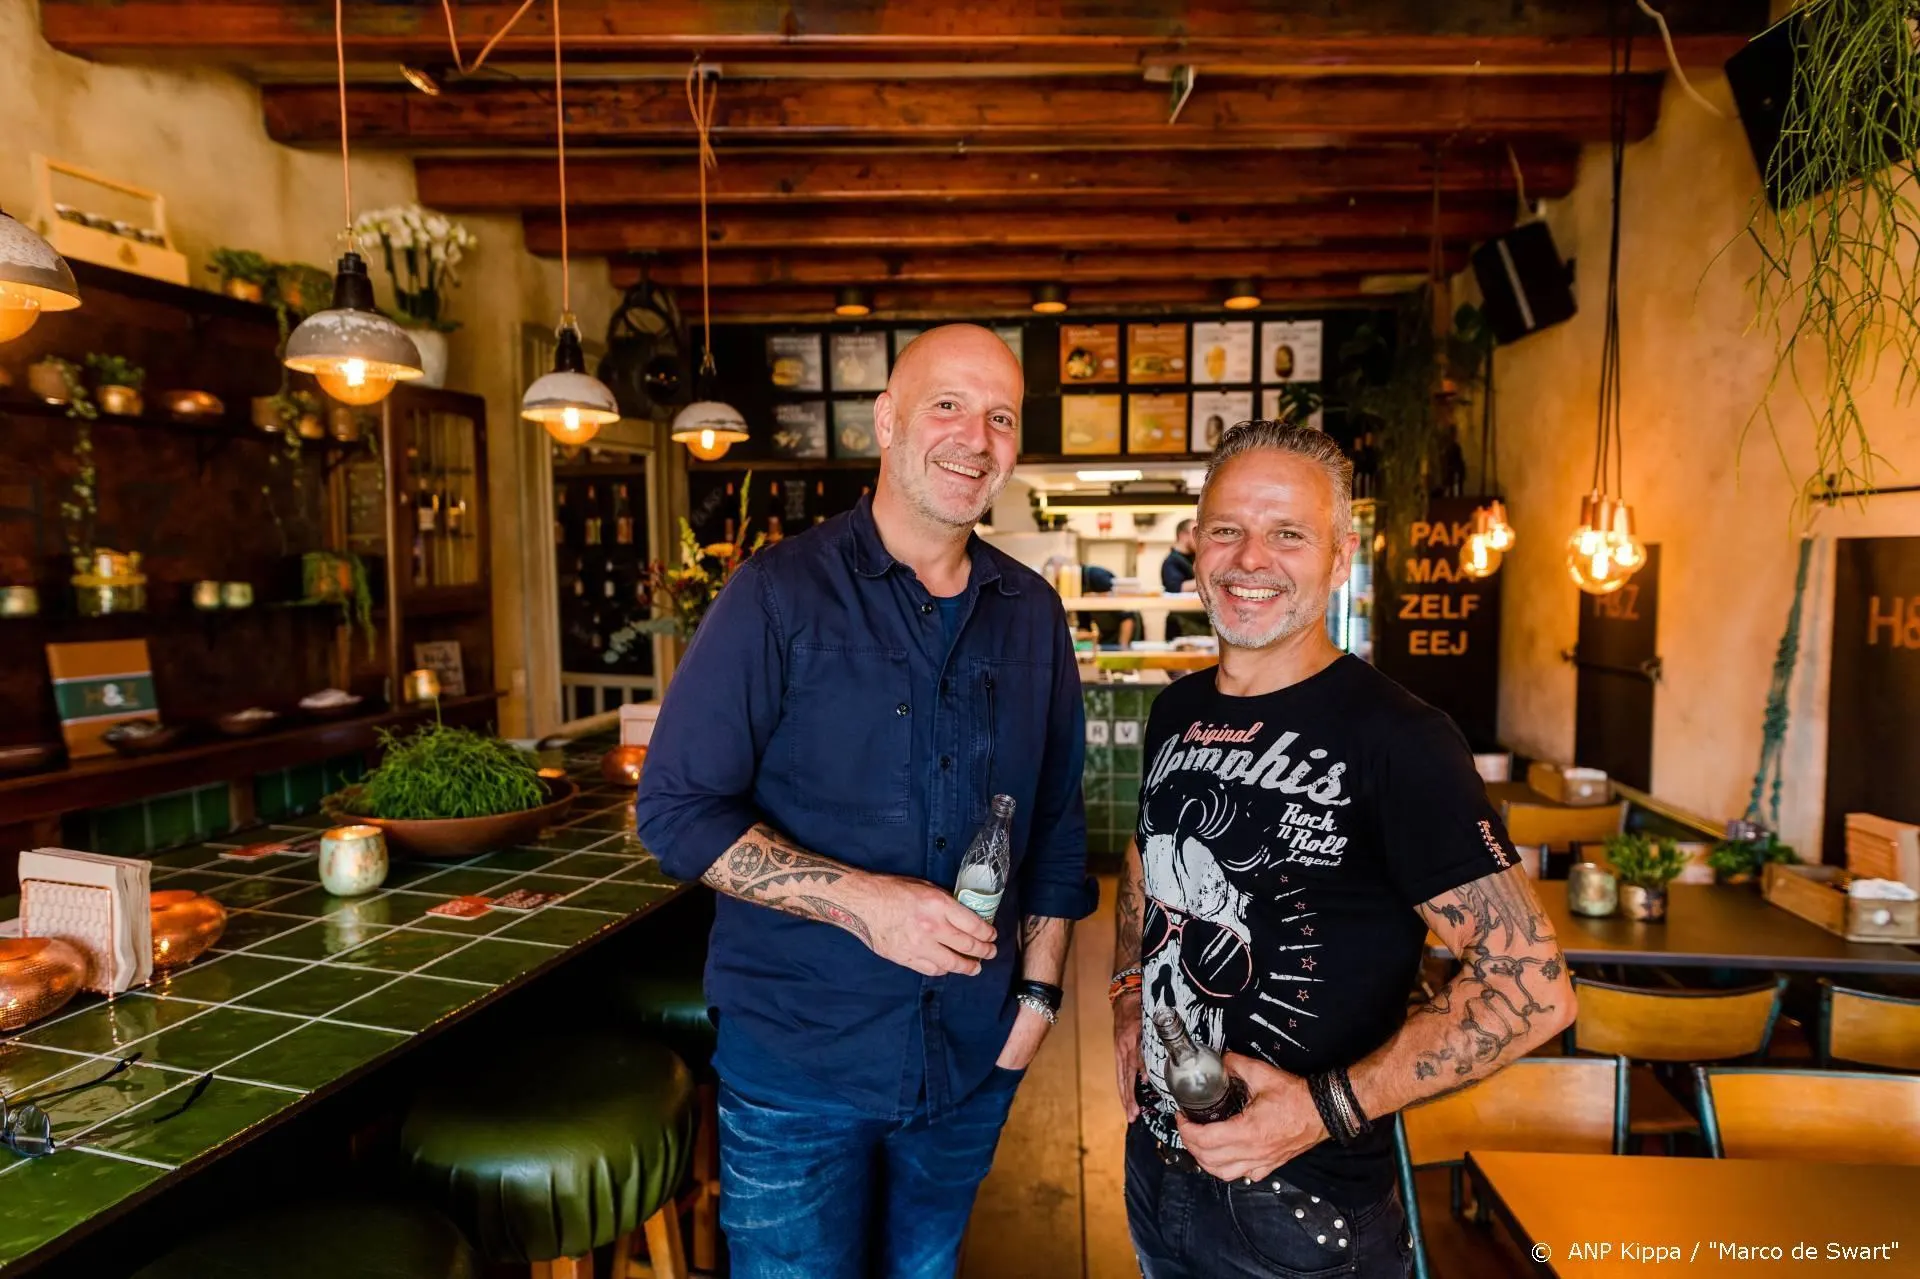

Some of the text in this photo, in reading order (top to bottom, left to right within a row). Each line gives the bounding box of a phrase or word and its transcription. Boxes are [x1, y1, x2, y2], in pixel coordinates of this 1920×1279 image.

[1410, 521, 1472, 546] PAK
[1399, 594, 1481, 619] ZELF
[1408, 630, 1469, 656] EEJ
[1182, 720, 1264, 746] Original
[1279, 802, 1338, 832] Rock
[1289, 827, 1348, 856] Roll
[1285, 848, 1343, 867] Legend
